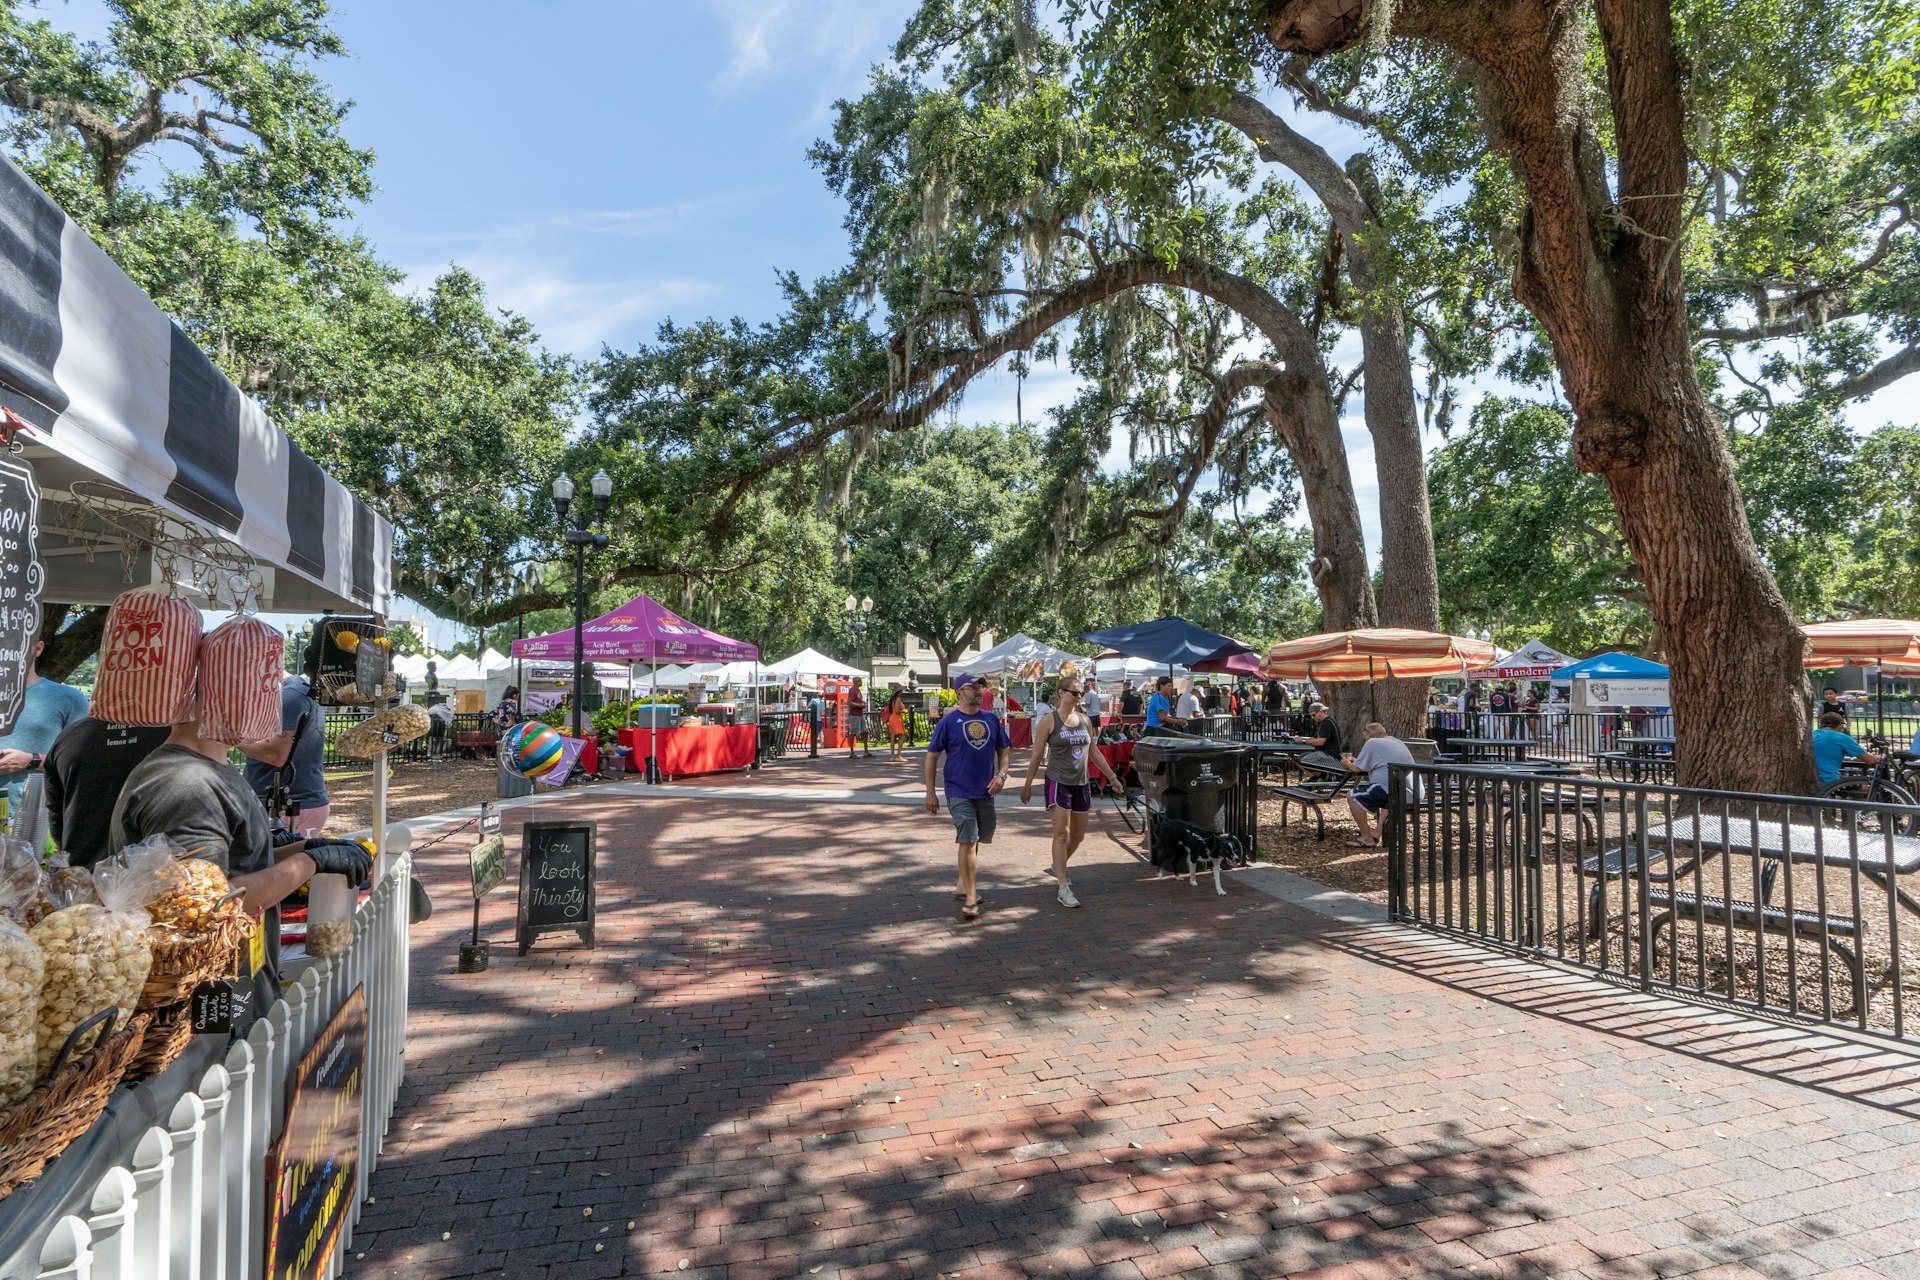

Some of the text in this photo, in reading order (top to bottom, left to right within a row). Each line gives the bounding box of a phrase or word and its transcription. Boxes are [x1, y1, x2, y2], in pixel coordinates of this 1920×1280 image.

[0, 508, 26, 533] RN
[111, 622, 164, 648] POP
[105, 646, 164, 671] CORN
[615, 648, 630, 656] Cups
[1505, 666, 1554, 677] Handcraf
[107, 735, 138, 747] lemon aid
[1070, 736, 1085, 744] CITY
[539, 836, 572, 859] You
[538, 861, 586, 880] look
[533, 886, 586, 918] Thirsty
[195, 994, 209, 1030] Caramel
[219, 992, 229, 1019] $3.00
